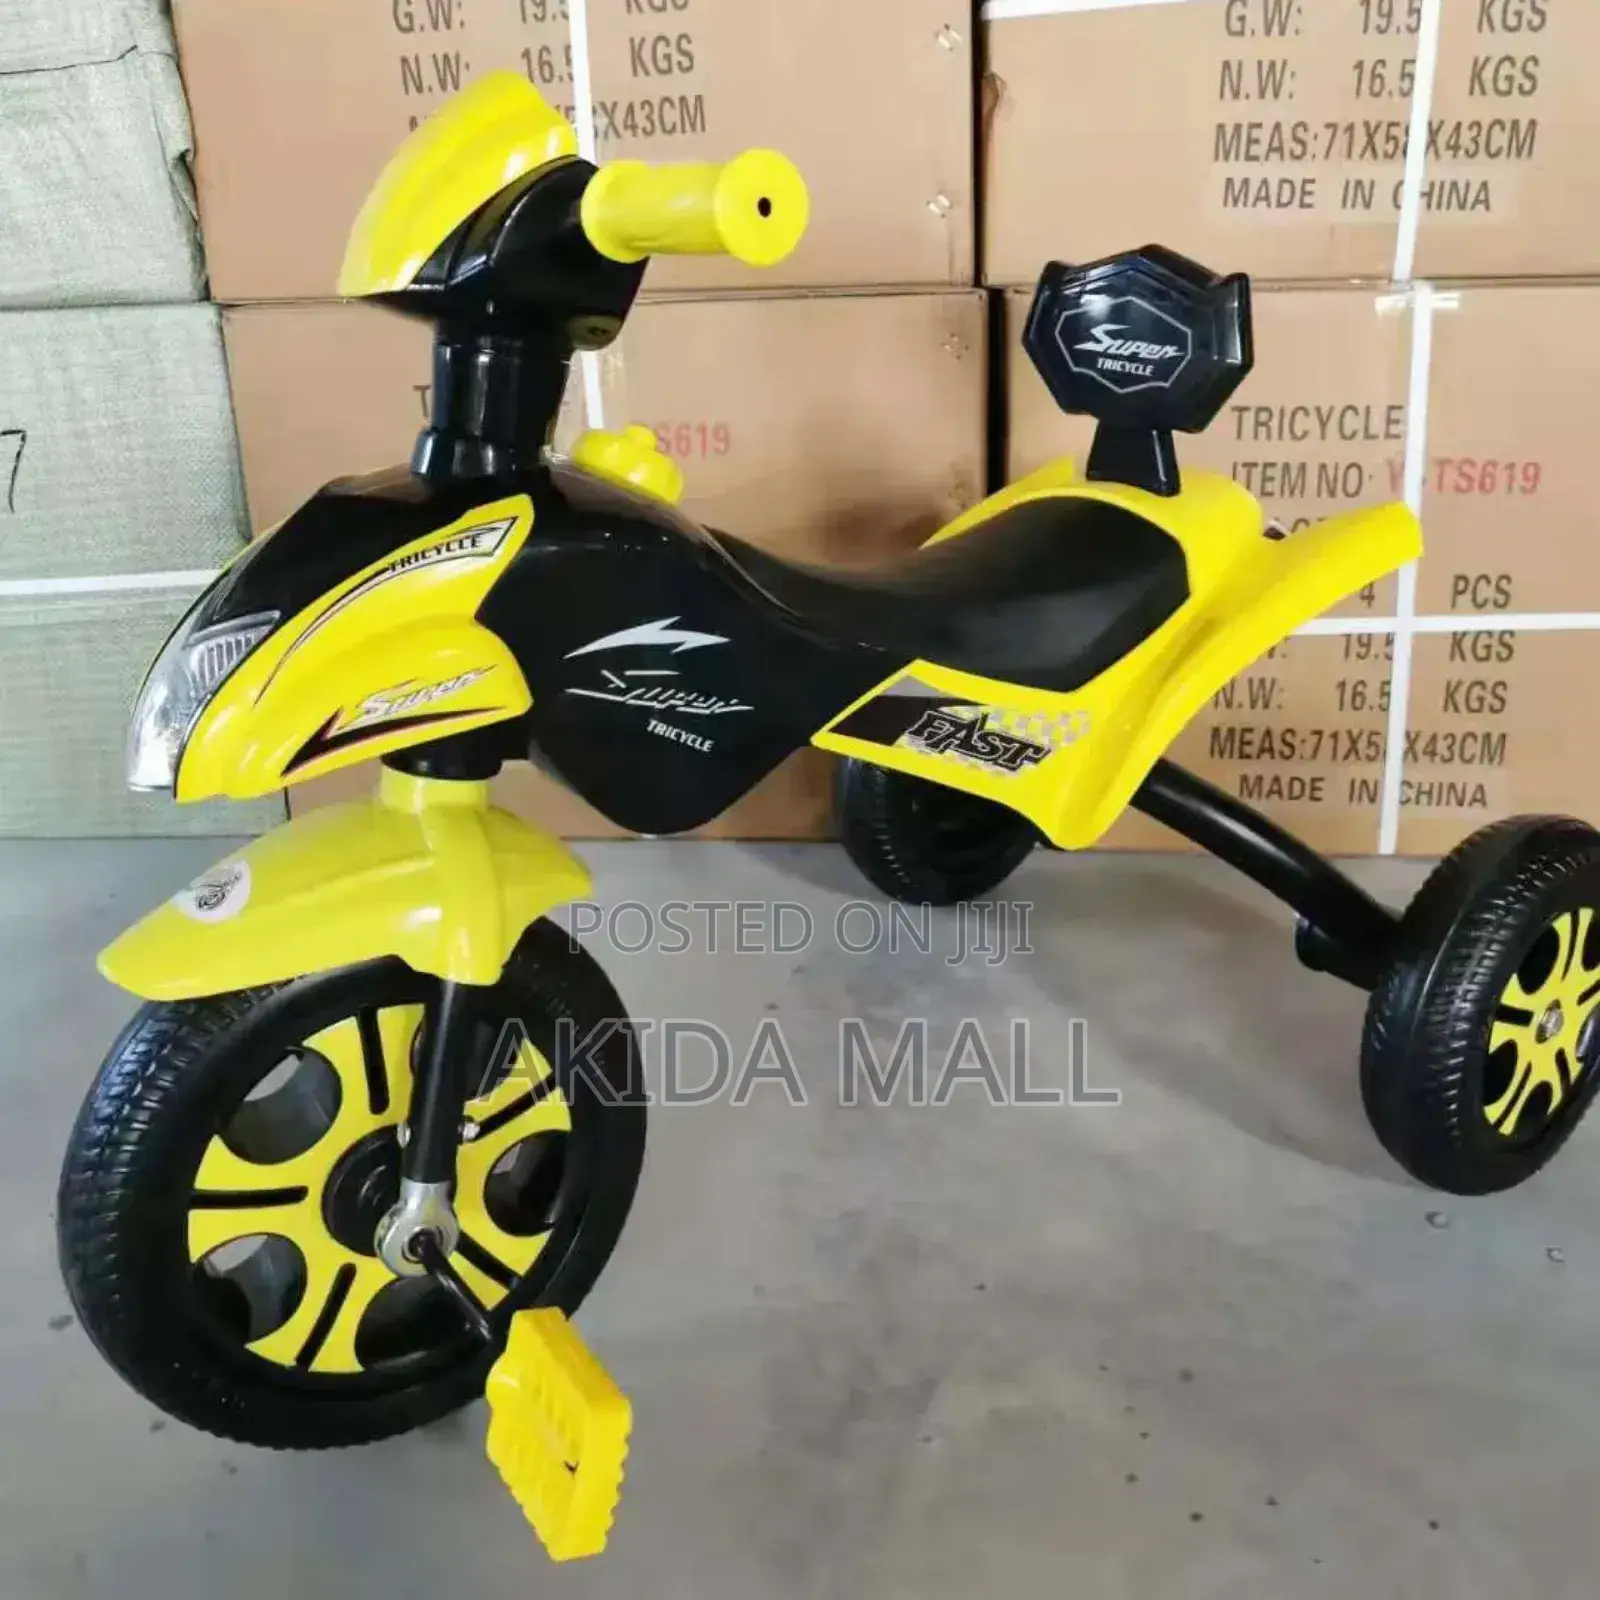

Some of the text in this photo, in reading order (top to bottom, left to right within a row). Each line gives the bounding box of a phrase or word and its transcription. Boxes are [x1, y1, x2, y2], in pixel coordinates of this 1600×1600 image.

[518, 0, 570, 24] 19.
[1224, 0, 1305, 37] G.W:
[1477, 0, 1547, 33] KGS
[629, 33, 695, 77] KGS
[1219, 55, 1541, 100] N.W: 16.5 KGS
[1223, 177, 1317, 209] MADE
[1341, 178, 1376, 210] IN
[1096, 357, 1155, 377] TRICYCLE
[1230, 404, 1405, 442] TRICYCLE
[1231, 461, 1307, 498] ITEM
[387, 533, 484, 573] TRICYCLE
[1451, 573, 1513, 610] PCS
[1448, 629, 1515, 663] KGS
[1443, 680, 1508, 714] KGS
[646, 718, 716, 753] TRICYCLE
[905, 707, 1053, 772] FAST
[1209, 726, 1507, 766] MEAS:71X5X43CM
[1238, 774, 1488, 809] MADE IN CHINA
